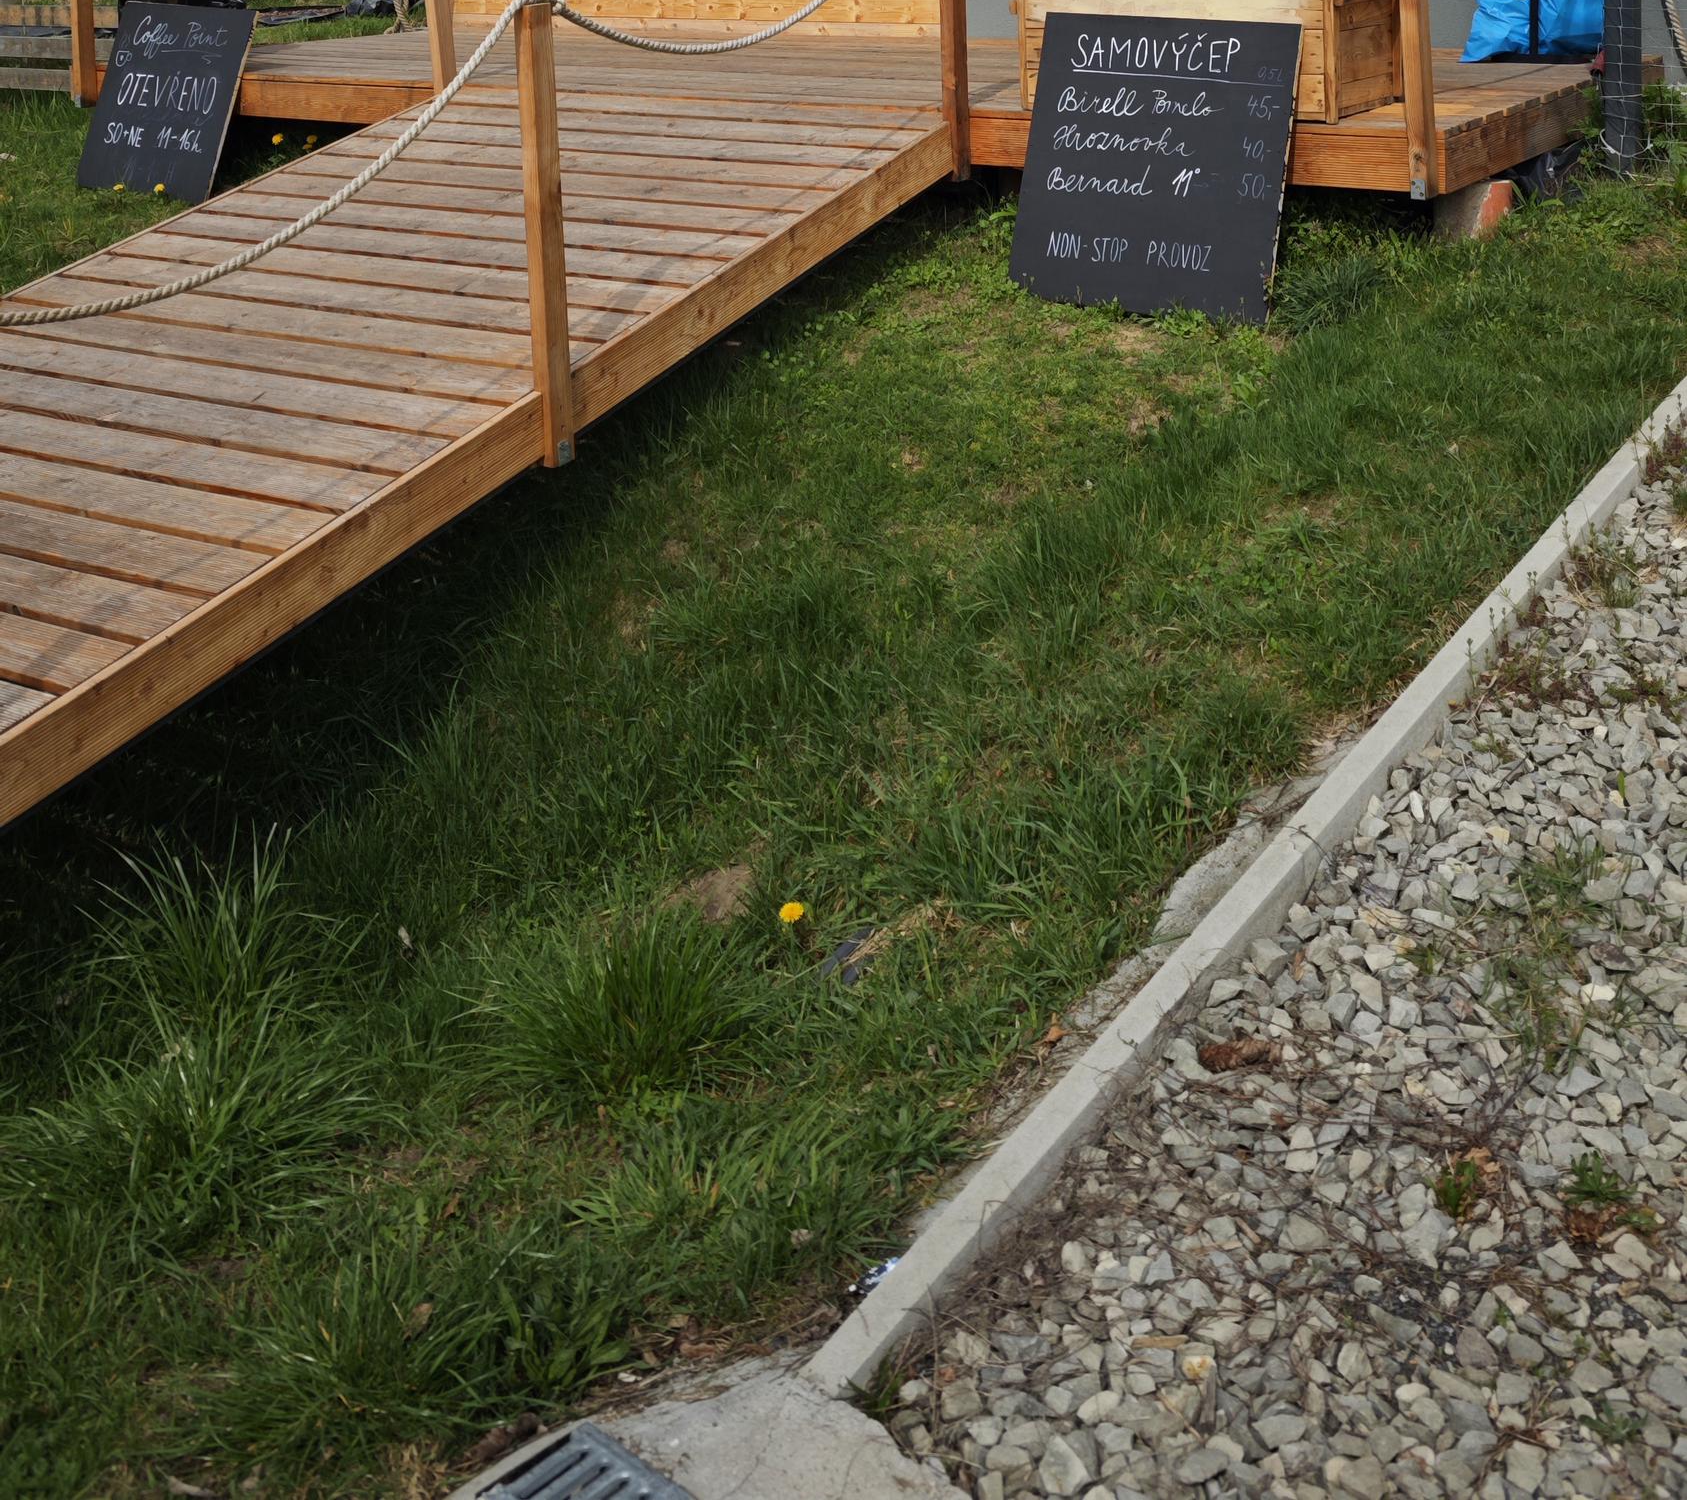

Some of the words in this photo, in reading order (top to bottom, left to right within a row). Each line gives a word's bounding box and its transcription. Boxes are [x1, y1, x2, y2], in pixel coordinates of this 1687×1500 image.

[133, 15, 180, 59] Coffee
[184, 21, 228, 49] Point
[1070, 32, 1241, 73] SAMOVÝČEP
[117, 71, 217, 115] OTEVŘENO
[1057, 86, 1145, 117] Birell
[1151, 89, 1225, 117] Pomelo
[1053, 124, 1195, 156] Hroznovka
[1046, 164, 1153, 197] Bernard
[1046, 230, 1129, 264] NON-STOP
[1146, 242, 1212, 272] PROVOZ
